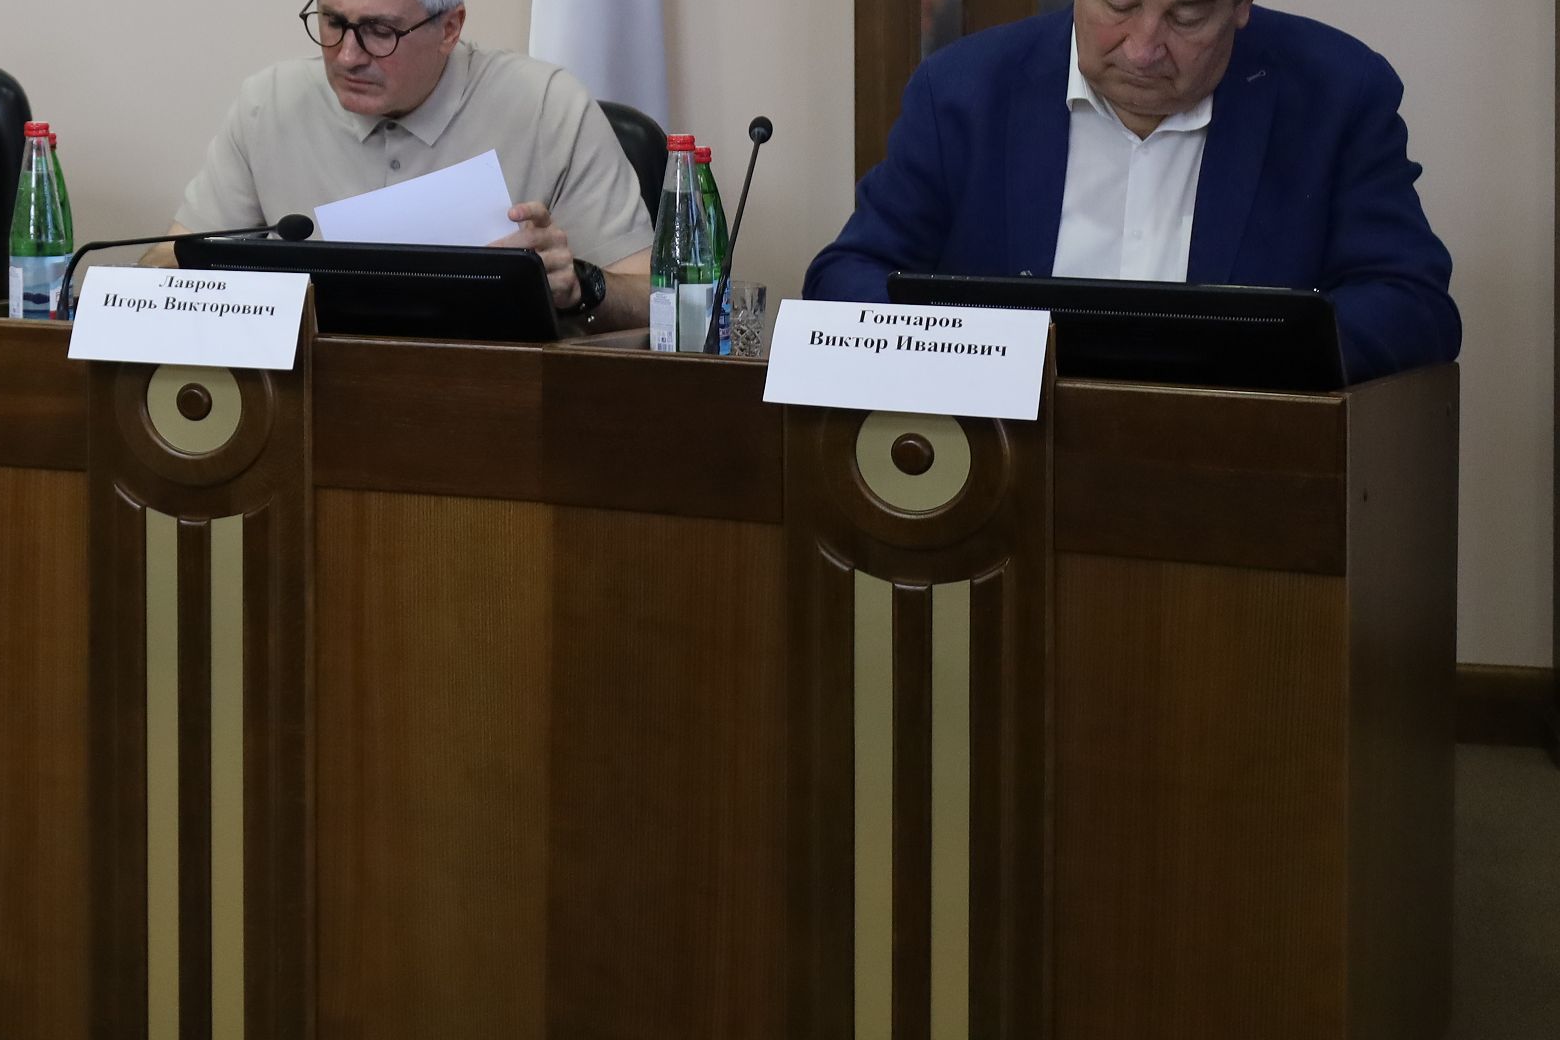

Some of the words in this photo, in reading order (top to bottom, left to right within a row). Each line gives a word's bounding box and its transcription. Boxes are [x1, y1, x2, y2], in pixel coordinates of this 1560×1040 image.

[158, 275, 227, 292] Лавров
[103, 293, 157, 312] Игорь
[163, 296, 276, 317] Викторович
[858, 310, 963, 330] Гончаров
[808, 330, 889, 353] Виктор
[895, 335, 1008, 357] Иванович
